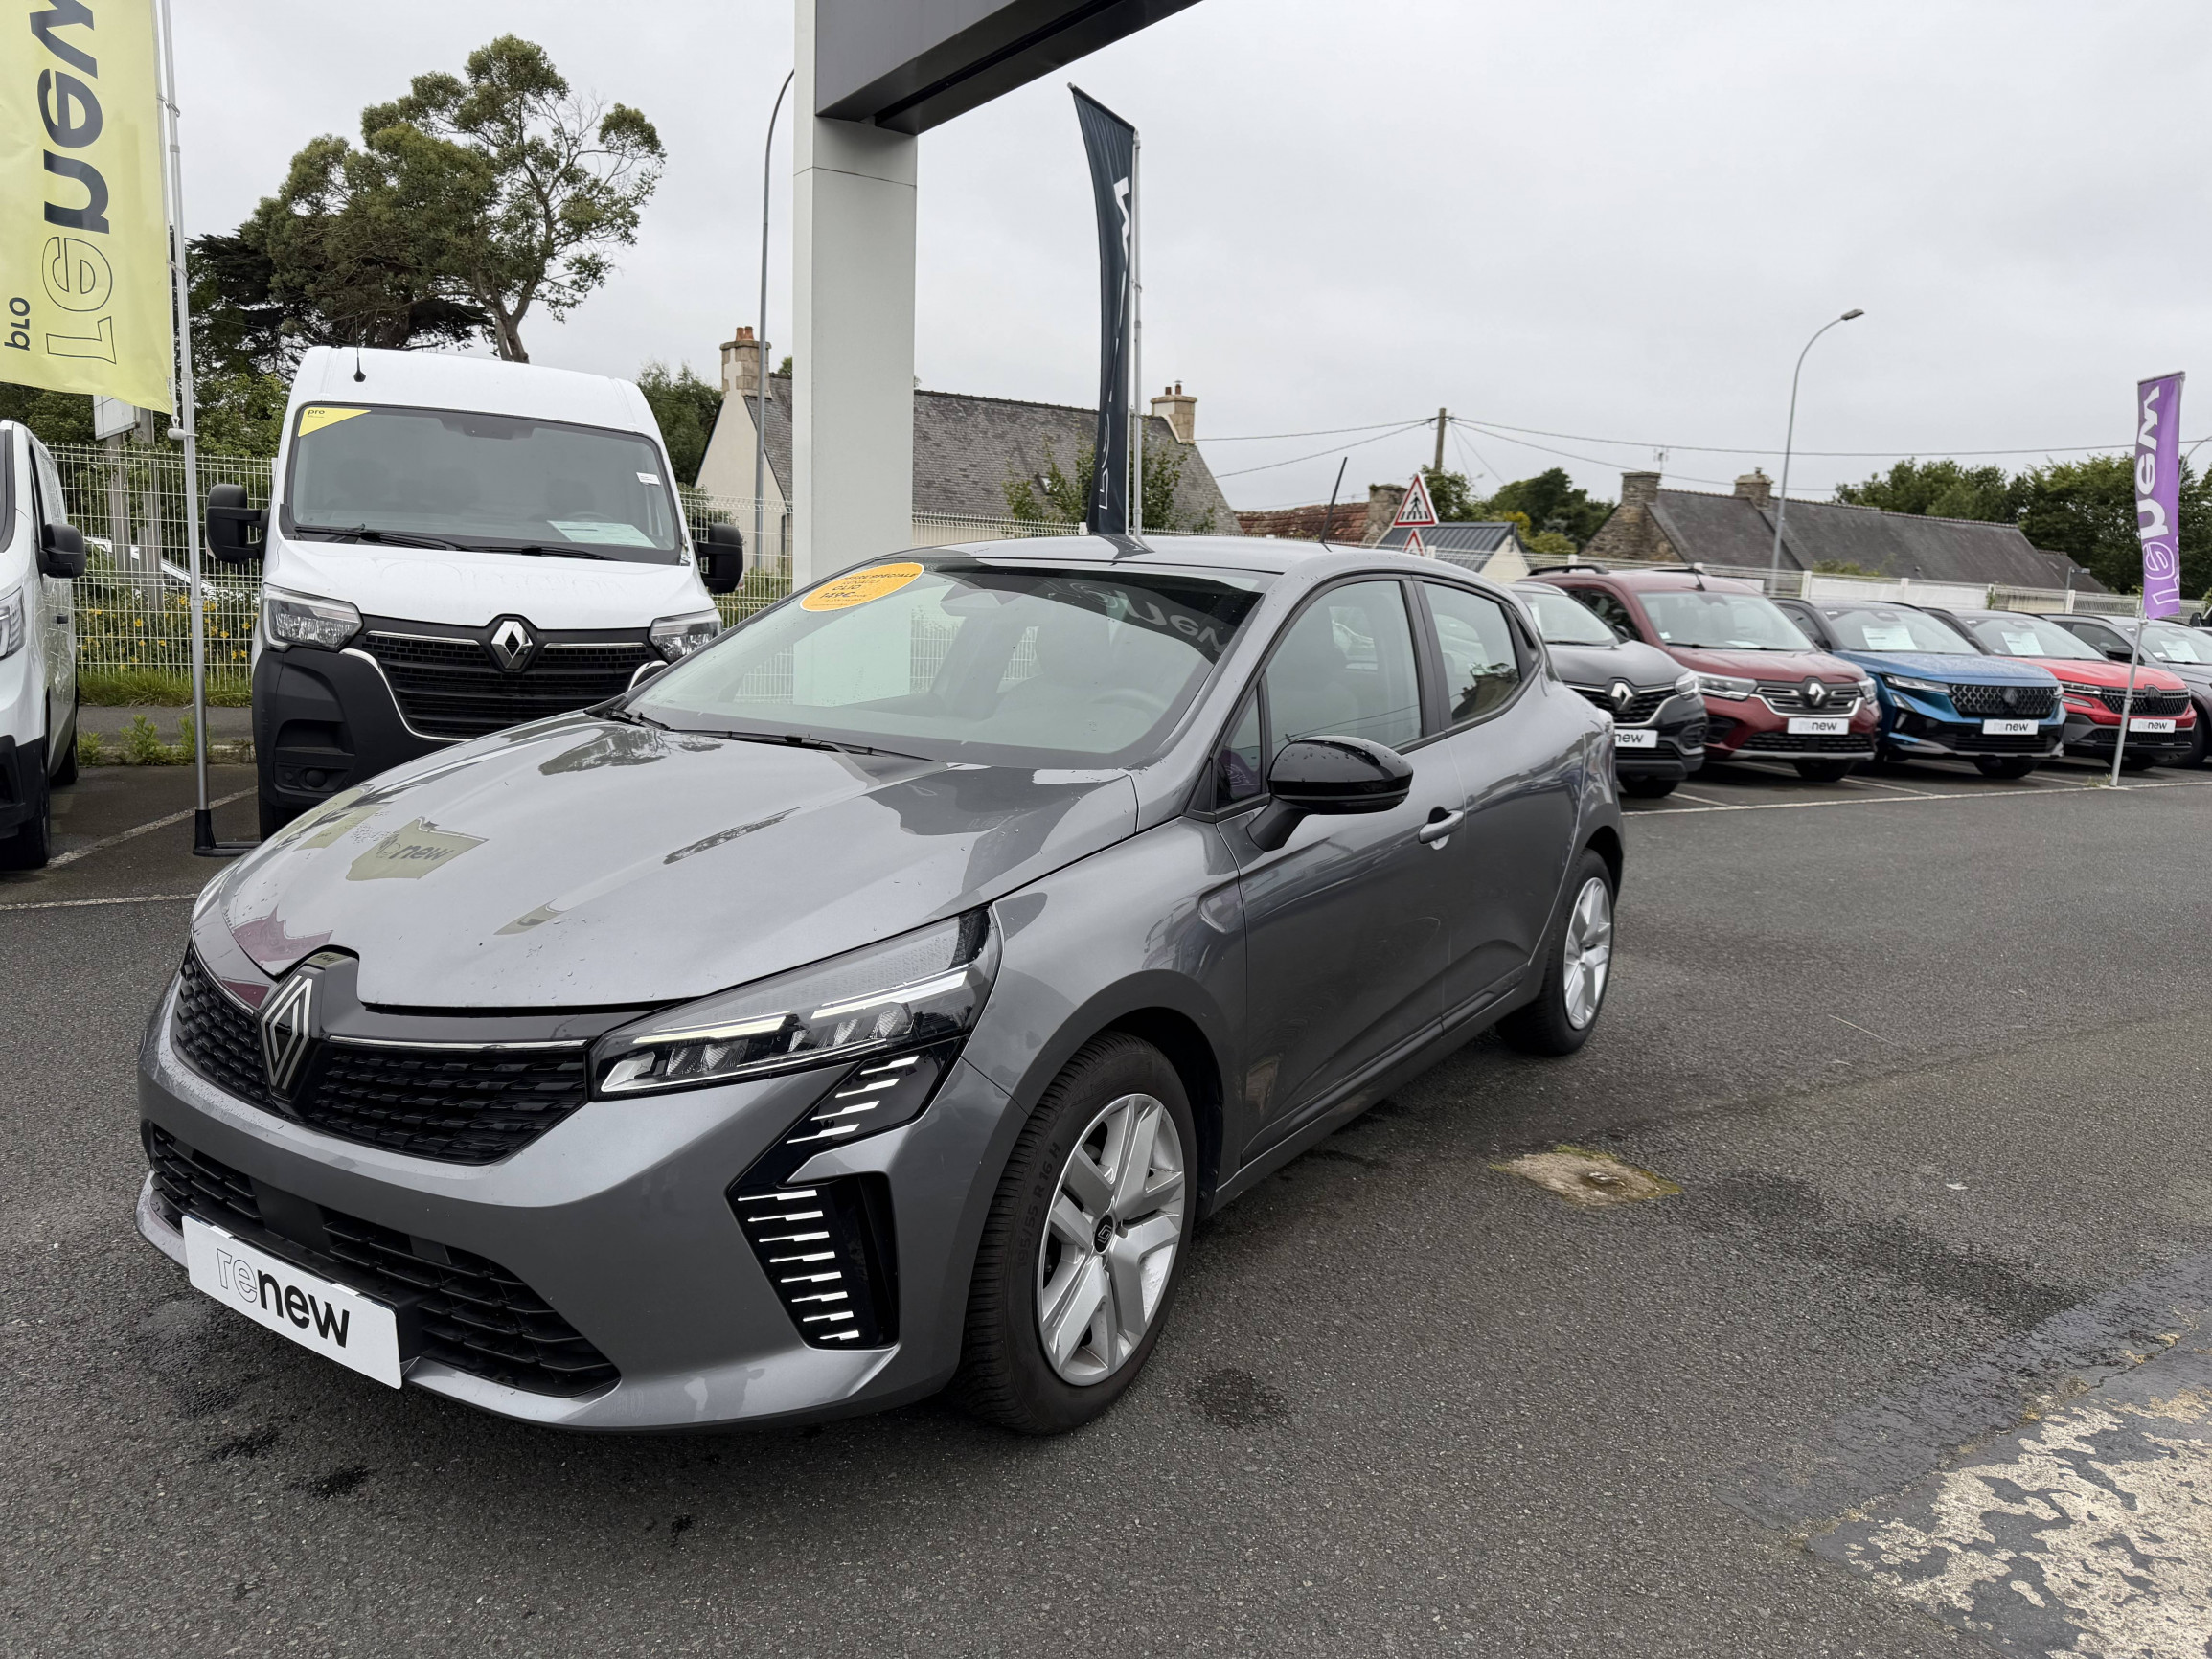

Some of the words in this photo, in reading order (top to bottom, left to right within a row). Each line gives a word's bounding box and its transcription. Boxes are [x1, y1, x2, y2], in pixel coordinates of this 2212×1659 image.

[1048, 1141, 1061, 1159] H
[1038, 1161, 1053, 1181] 16
[1033, 1184, 1045, 1199] R
[1017, 1203, 1039, 1270] 195/55
[216, 1247, 351, 1349] renew
